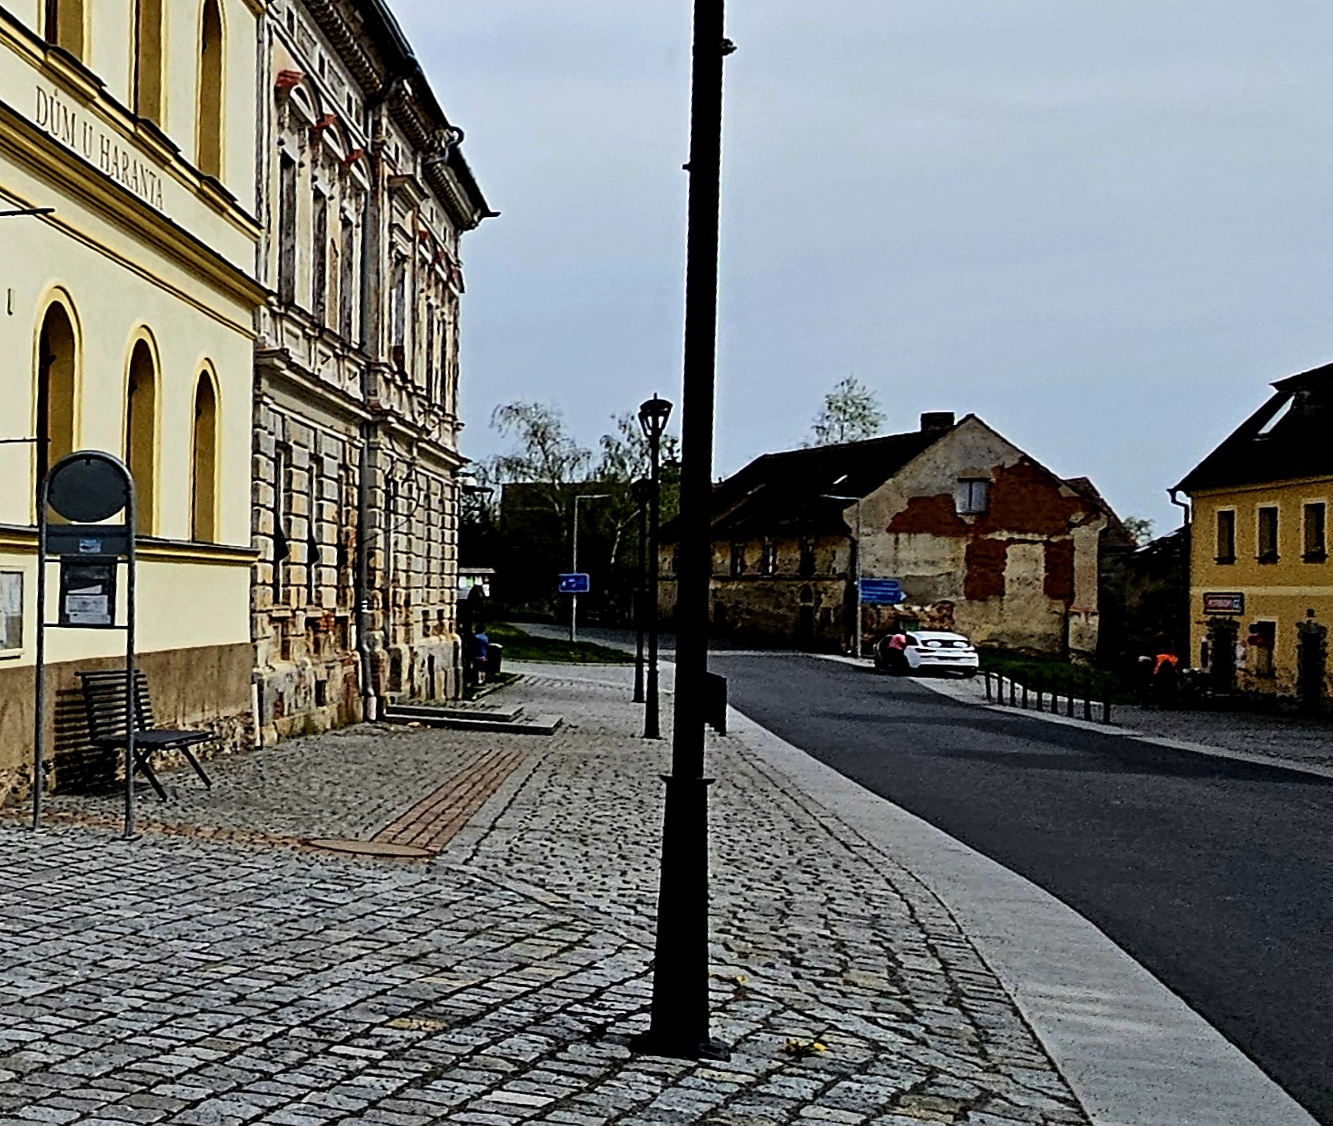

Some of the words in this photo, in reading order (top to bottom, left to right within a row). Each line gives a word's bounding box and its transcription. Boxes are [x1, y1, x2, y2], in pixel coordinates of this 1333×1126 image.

[35, 85, 76, 149] DŮM
[83, 121, 93, 159] U
[99, 133, 164, 211] HARANTA
